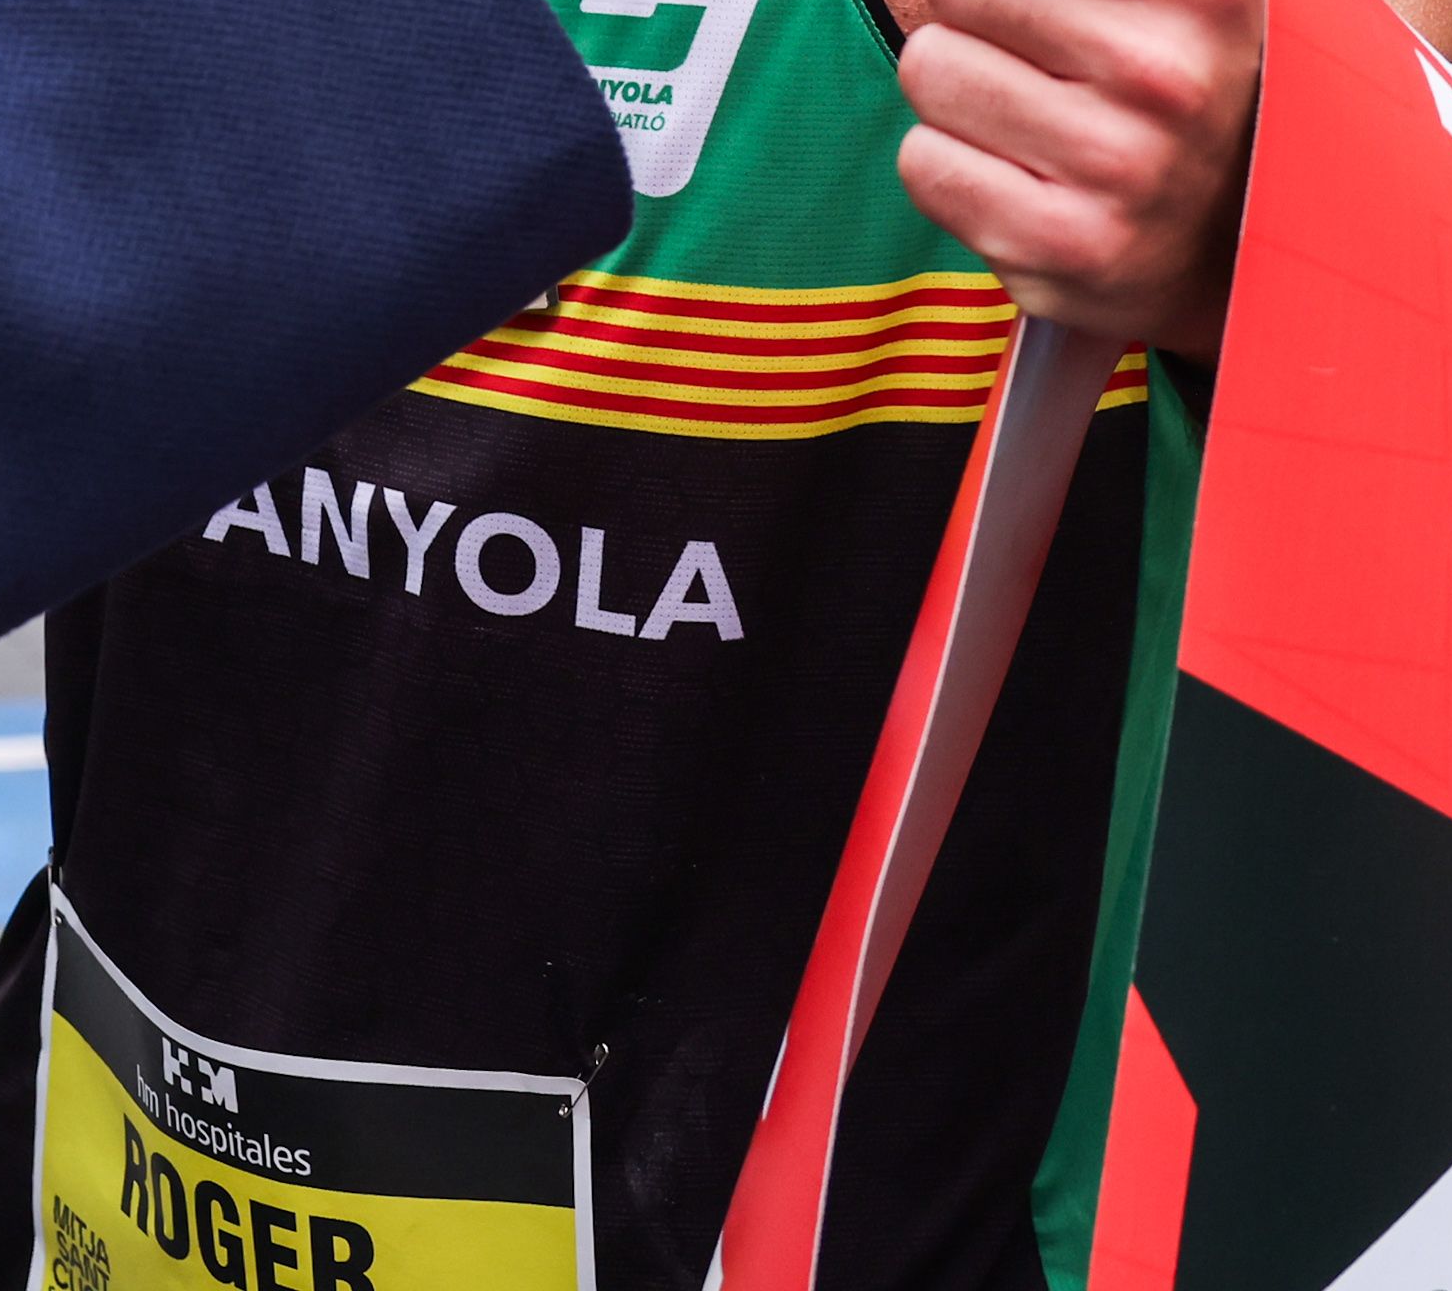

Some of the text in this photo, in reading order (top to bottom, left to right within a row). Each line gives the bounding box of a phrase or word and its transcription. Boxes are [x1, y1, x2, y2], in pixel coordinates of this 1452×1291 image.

[136, 1064, 311, 1176] hm hospitales
[53, 1194, 111, 1275] MITJA
[120, 1113, 375, 1291] ROGER
[52, 1257, 97, 1291] CU
